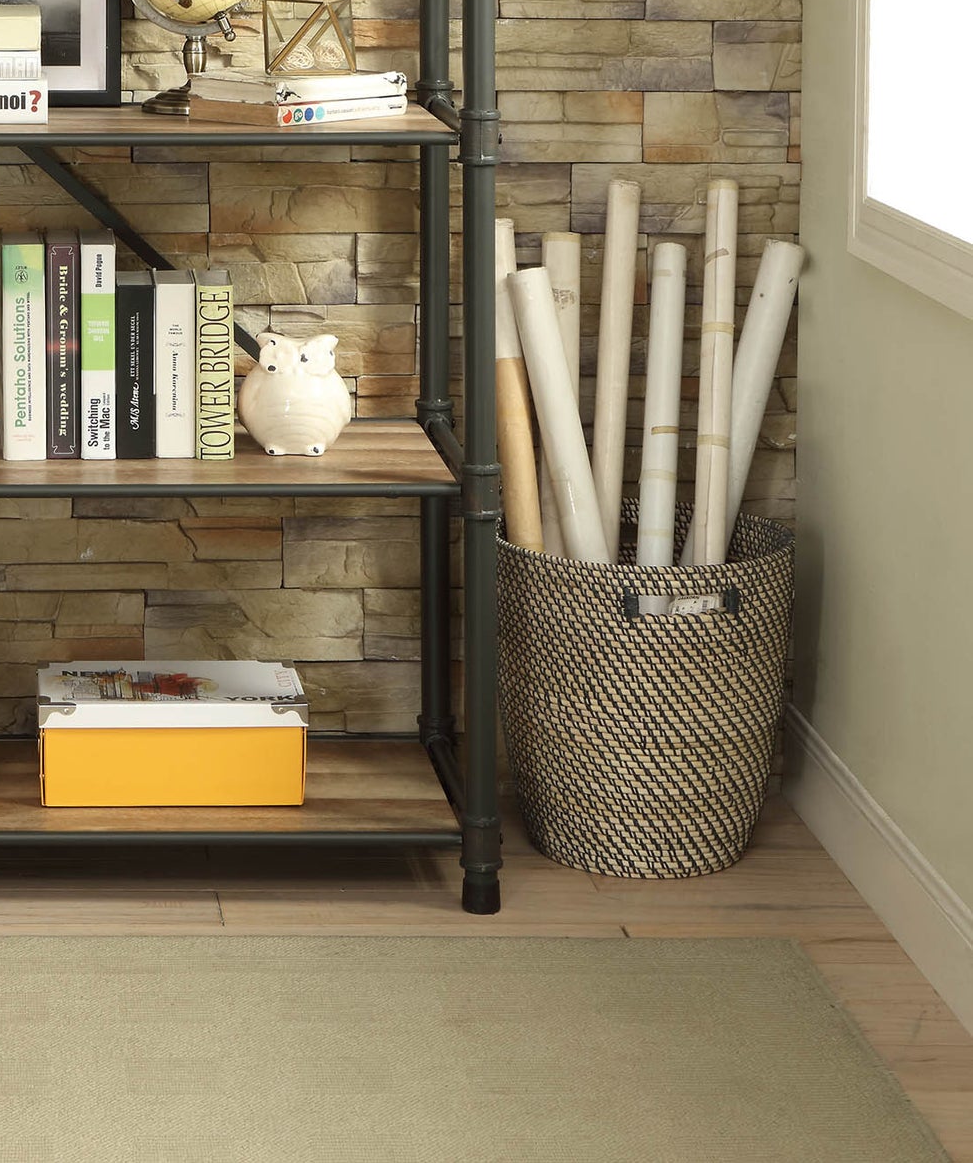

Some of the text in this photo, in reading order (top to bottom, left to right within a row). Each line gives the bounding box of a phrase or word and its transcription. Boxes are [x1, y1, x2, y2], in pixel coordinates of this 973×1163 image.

[14, 297, 25, 363] Solutions
[58, 265, 69, 437] Bride & Groom's wedding
[14, 368, 27, 428] Pentaho
[199, 291, 231, 460] TOWER BRIDGE
[87, 398, 101, 447] Switching
[100, 407, 110, 429] Mac
